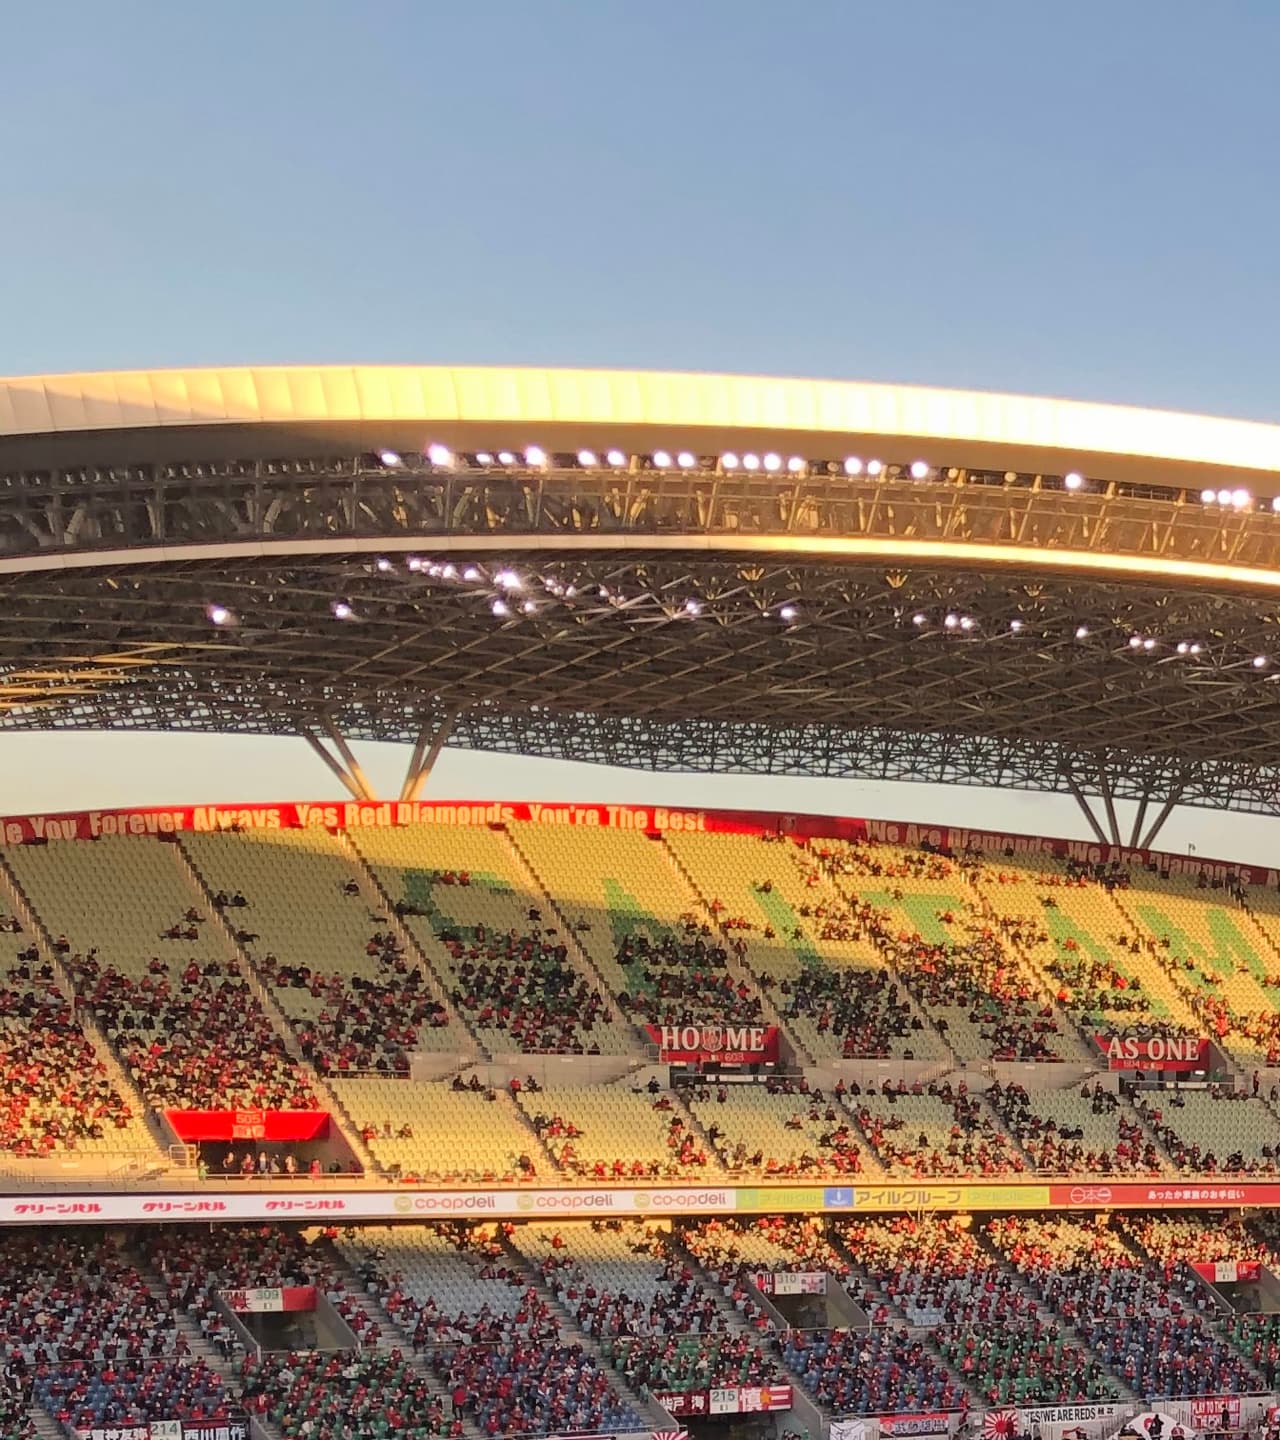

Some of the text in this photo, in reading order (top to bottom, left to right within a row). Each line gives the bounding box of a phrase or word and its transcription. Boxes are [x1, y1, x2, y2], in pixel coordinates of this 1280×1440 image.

[29, 807, 280, 841] You Forever Always
[294, 804, 338, 827] Yes
[345, 803, 391, 825] Red
[527, 803, 706, 831] You're The Best
[866, 818, 899, 842] We
[907, 822, 942, 847] Are
[1068, 840, 1100, 864] We
[1108, 844, 1142, 866] Are
[1107, 1037, 1200, 1061] AS ONE
[711, 1390, 736, 1402] 215
[1057, 1408, 1074, 1422] ARE
[1074, 1407, 1096, 1421] REDS
[150, 1422, 179, 1436] 214
